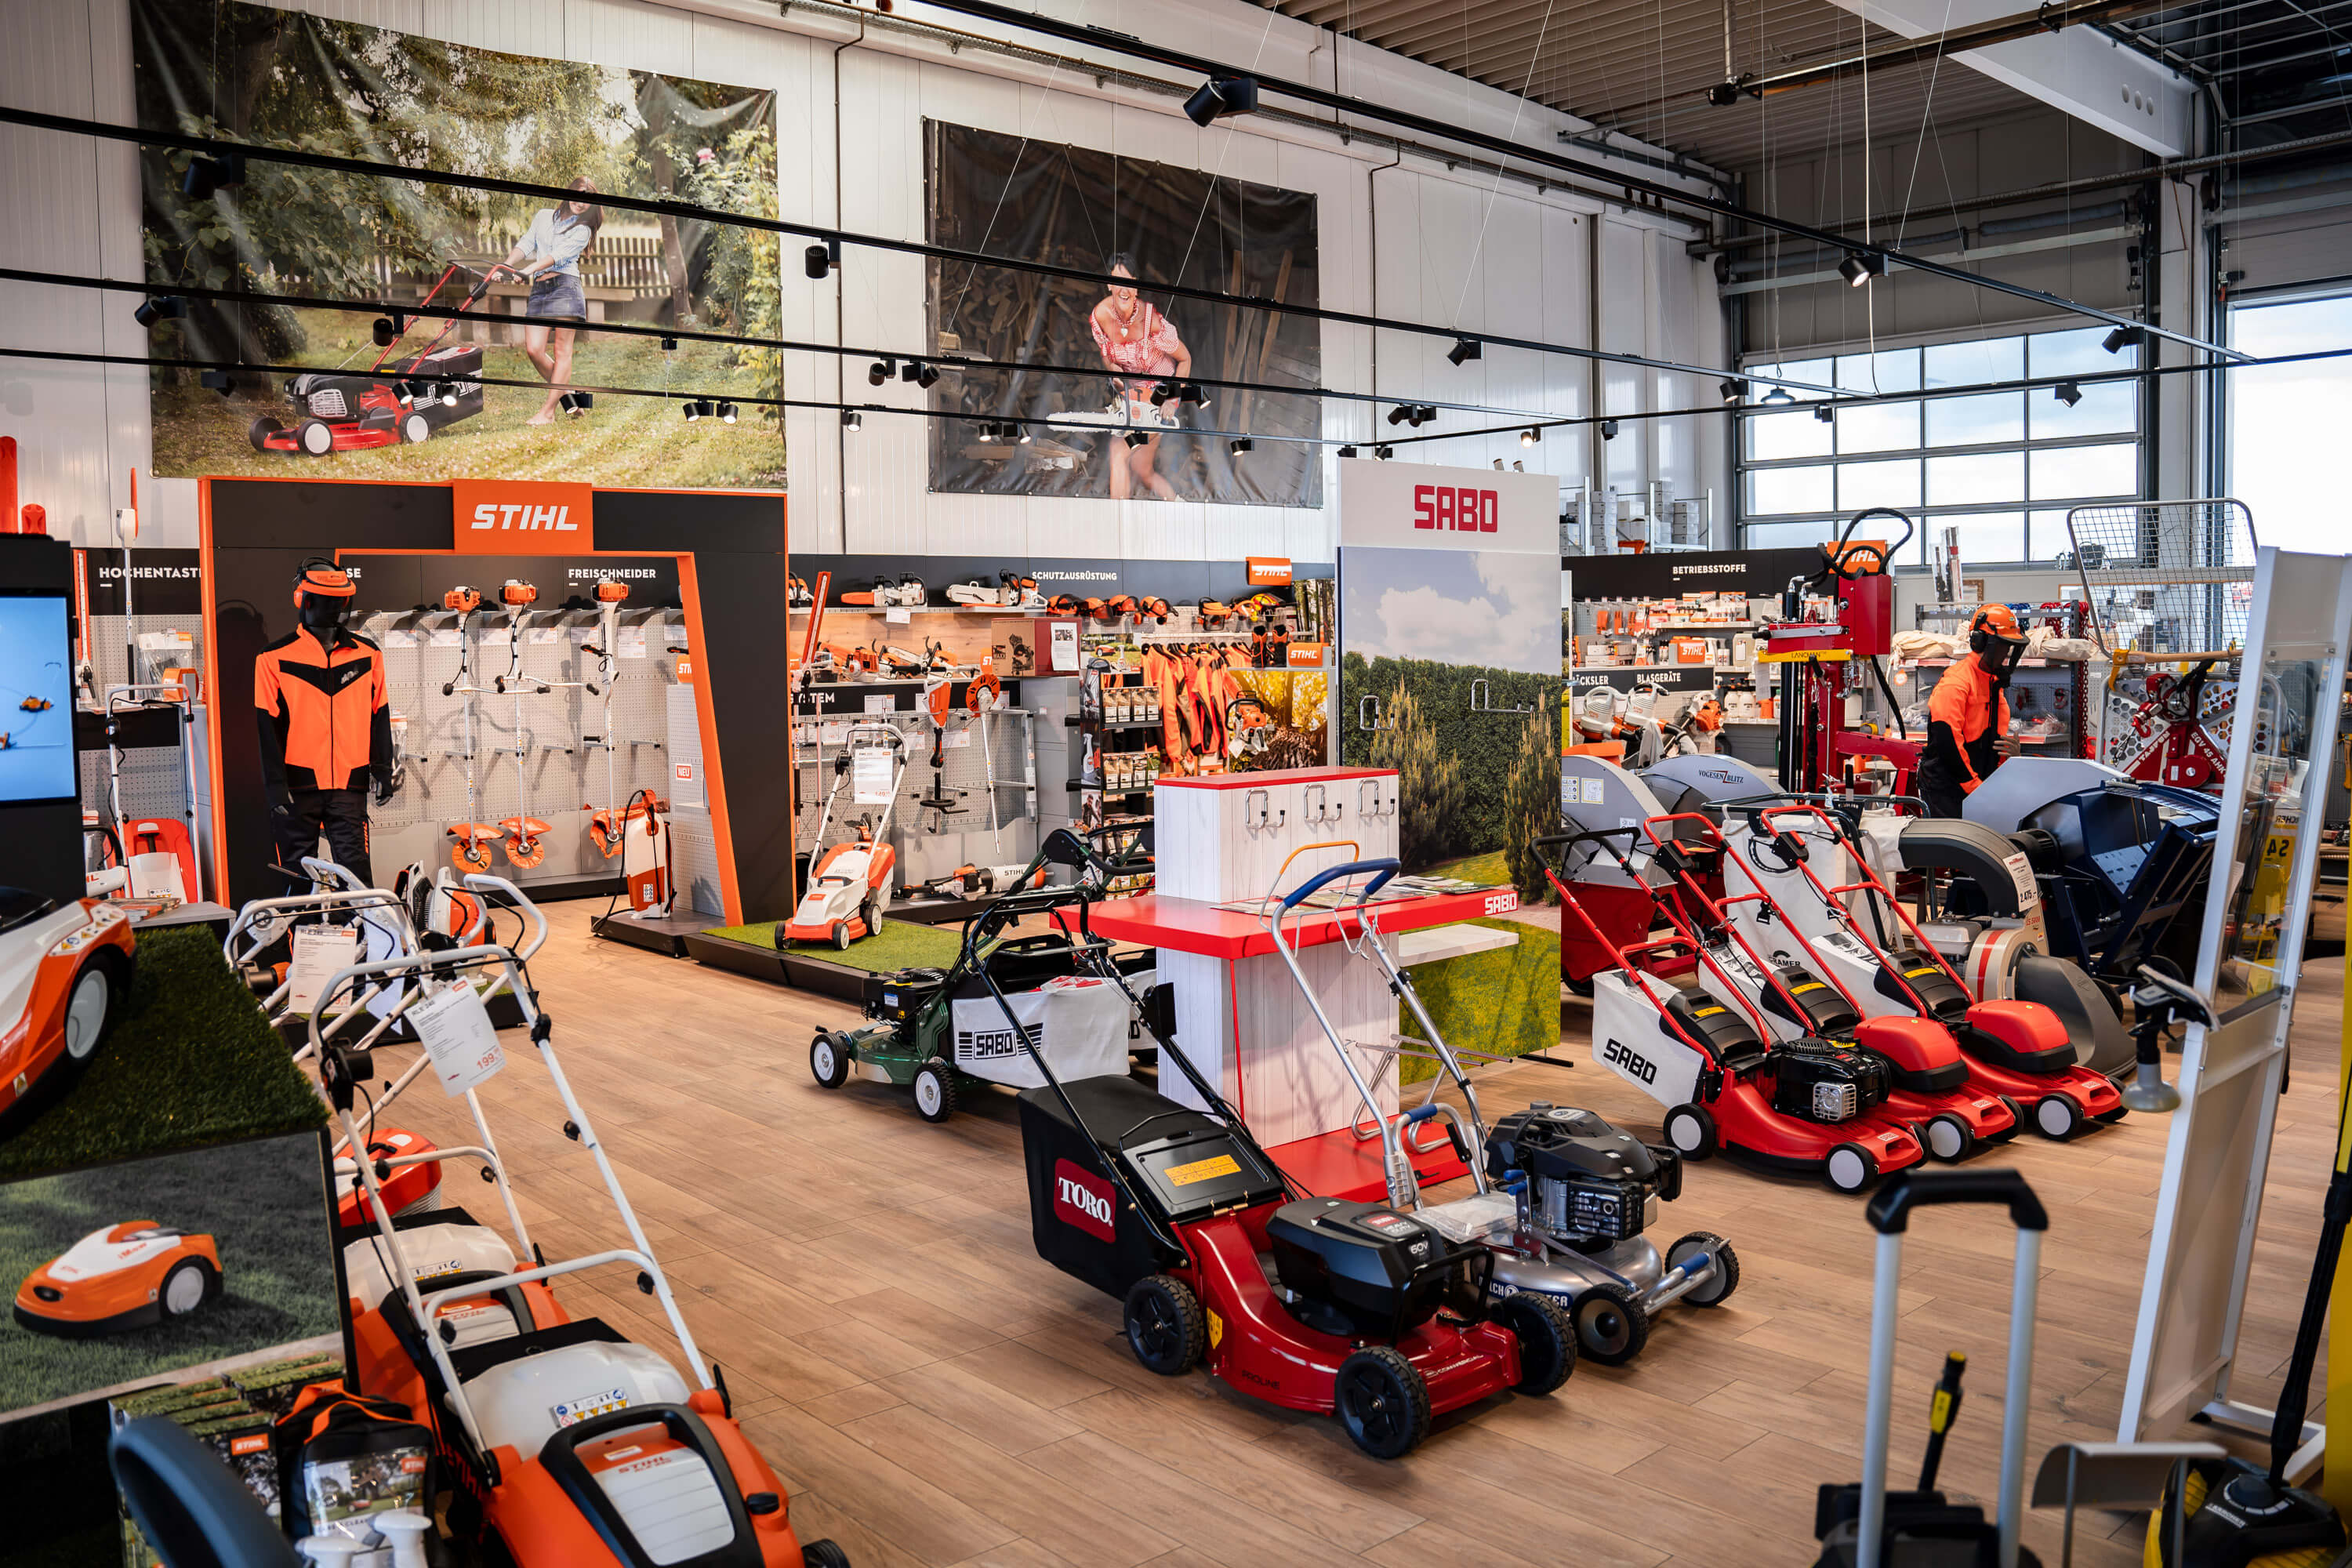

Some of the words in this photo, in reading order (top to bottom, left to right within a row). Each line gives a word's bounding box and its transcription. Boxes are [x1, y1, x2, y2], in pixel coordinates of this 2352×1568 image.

[1414, 485, 1498, 533] SABO
[470, 503, 579, 531] STIHL
[99, 567, 201, 579] HOCHENTAST
[568, 568, 657, 579] FREISCHNEIDER
[1032, 571, 1118, 581] SCHUTZAUSRÜSTUNG
[1672, 564, 1747, 575] BETRIEBSSTOFFE
[1290, 650, 1318, 659] STIHL
[1682, 645, 1705, 656] STIHL
[1637, 670, 1681, 684] BLASGERÄTE
[1484, 892, 1518, 915] SABO
[976, 1032, 1014, 1056] SABO
[1603, 1038, 1657, 1085] SABO
[1058, 1176, 1112, 1224] TORO
[1410, 1240, 1429, 1254] 60V
[236, 1439, 266, 1451] STIHL
